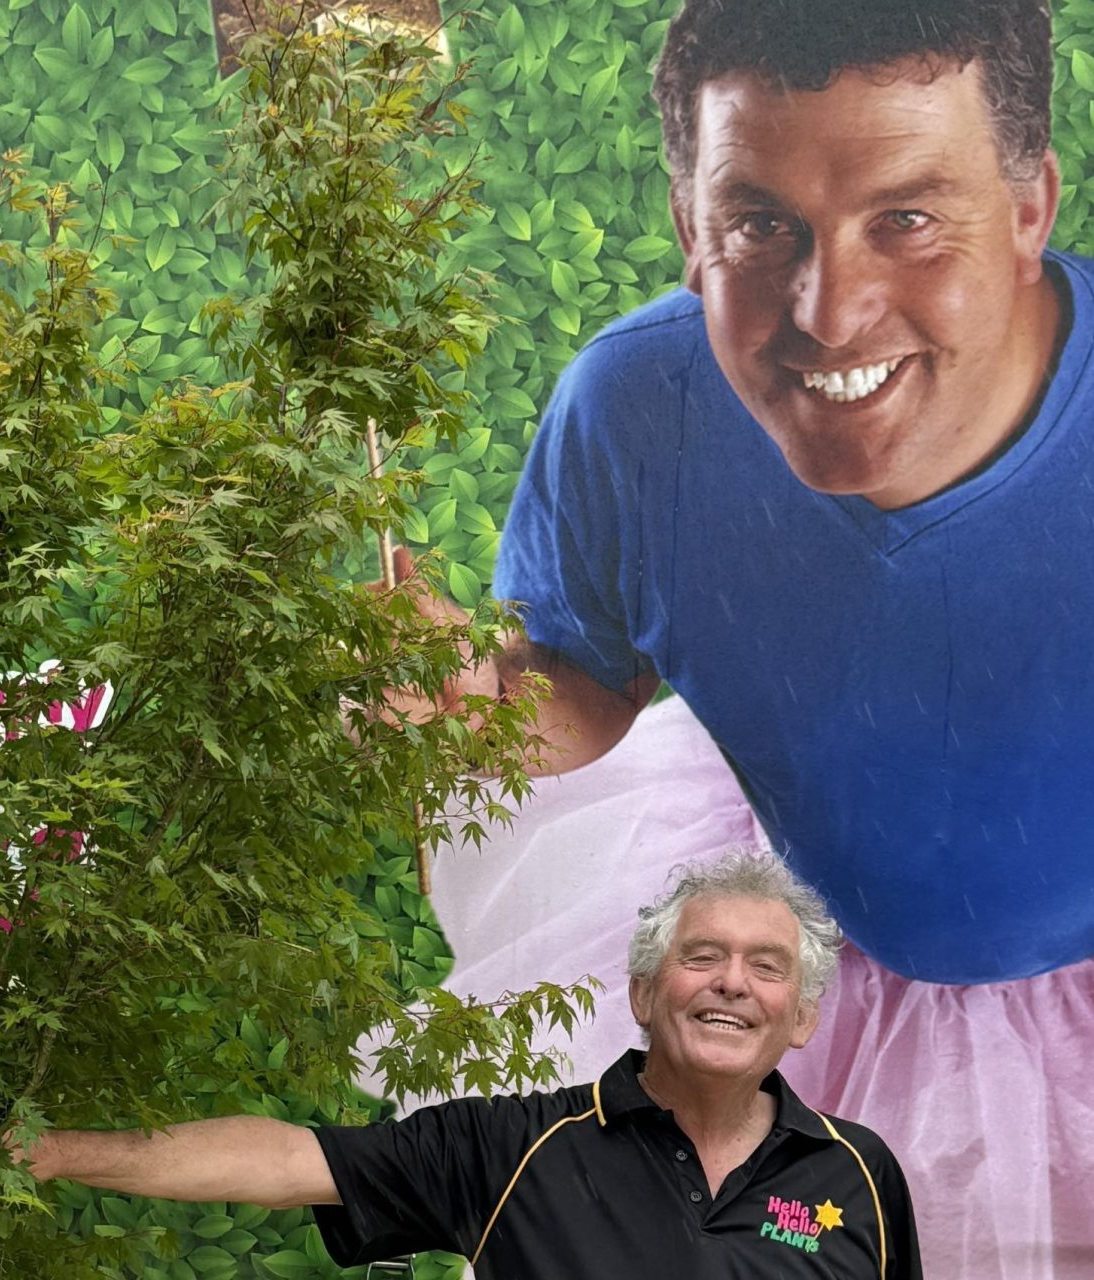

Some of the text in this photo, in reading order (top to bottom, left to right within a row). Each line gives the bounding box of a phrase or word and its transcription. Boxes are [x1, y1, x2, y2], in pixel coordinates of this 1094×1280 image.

[768, 1196, 810, 1217] Hello
[777, 1212, 819, 1235] Hello
[760, 1221, 820, 1253] PLANTS
